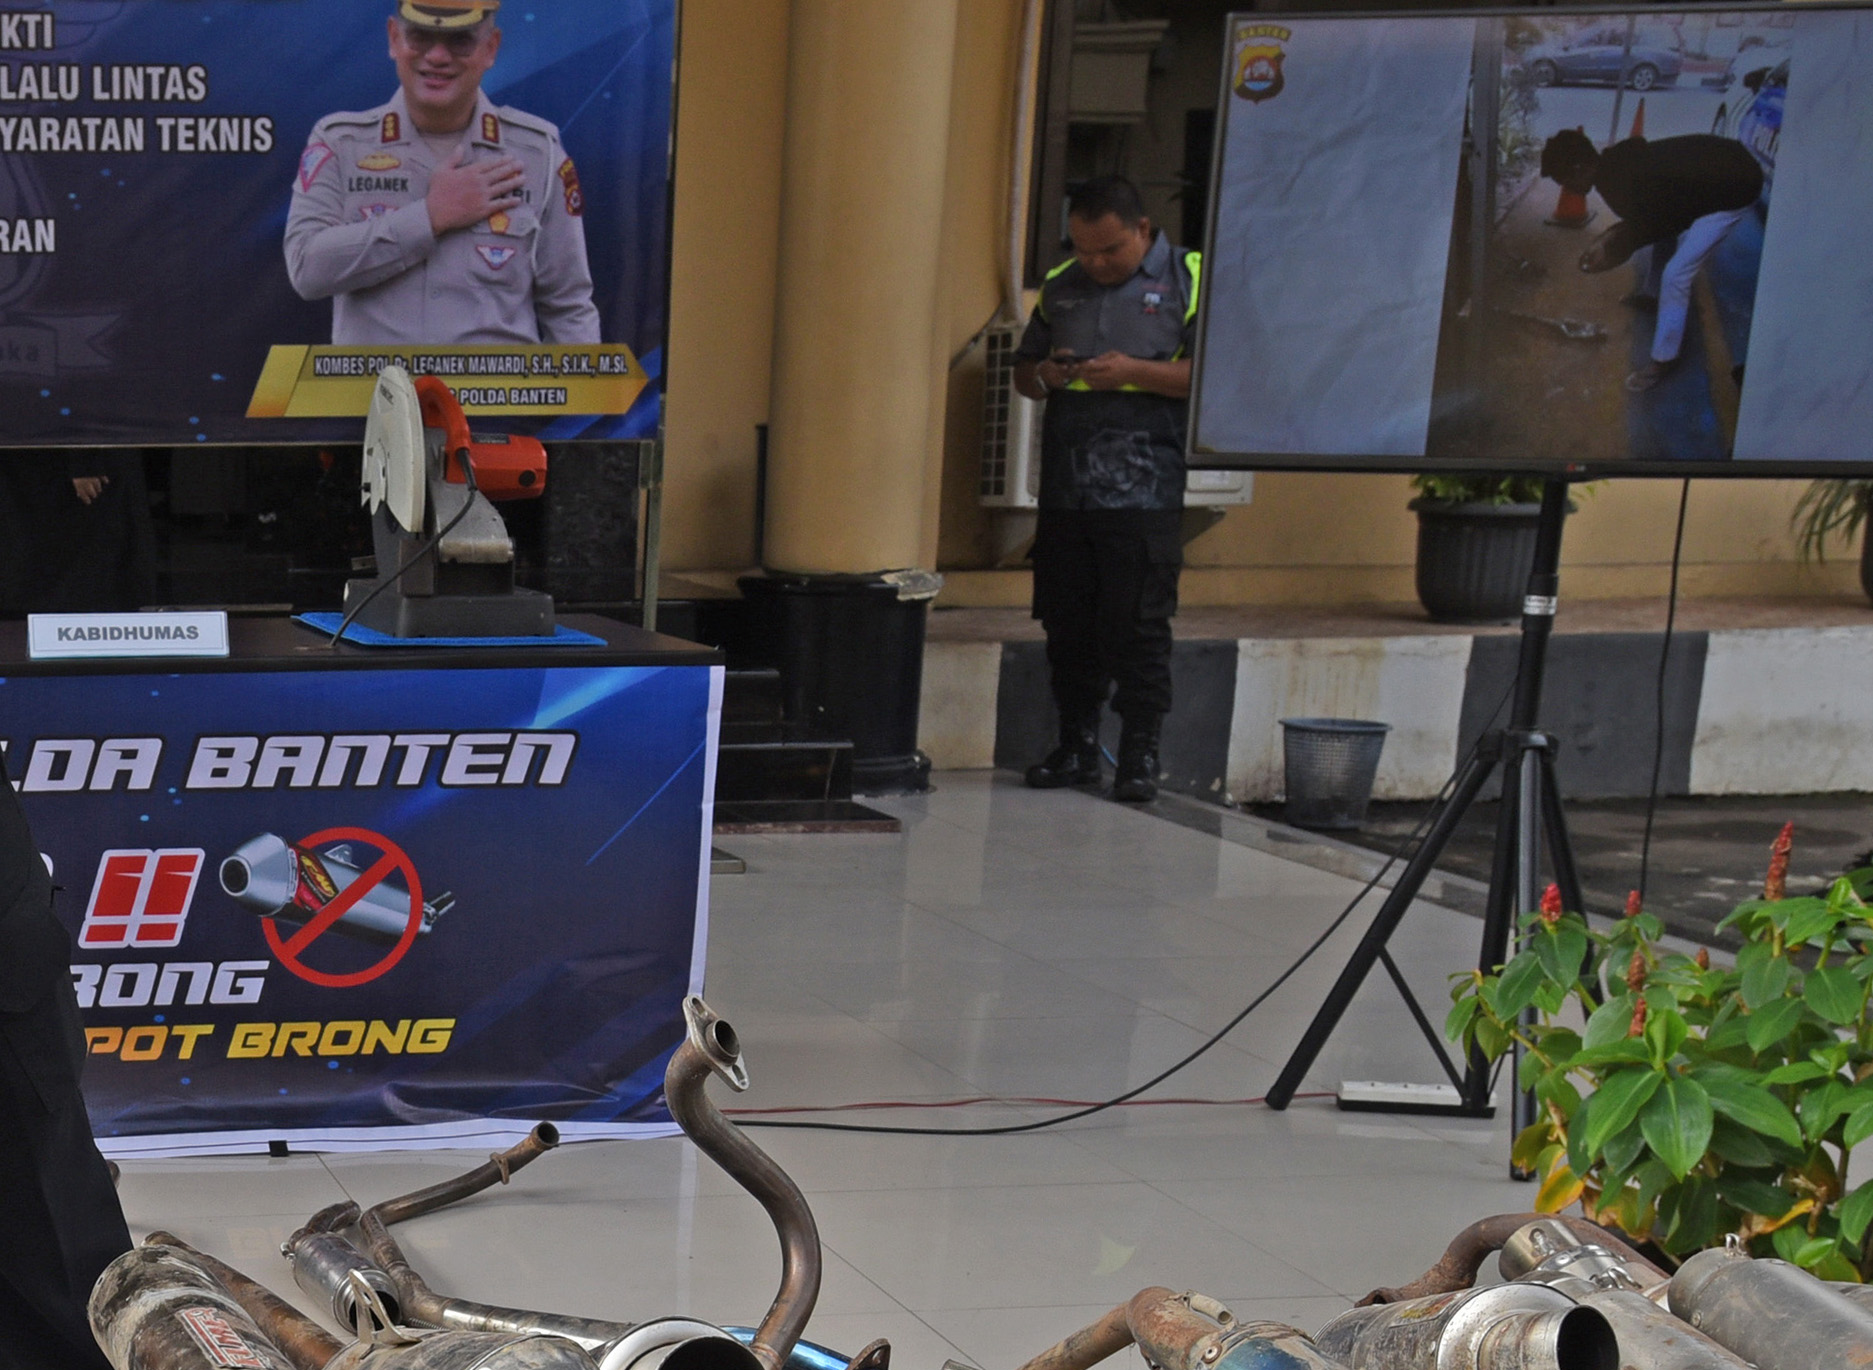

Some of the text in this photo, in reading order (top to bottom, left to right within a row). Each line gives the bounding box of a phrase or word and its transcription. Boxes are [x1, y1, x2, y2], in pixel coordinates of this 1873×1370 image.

[0, 65, 81, 101] LALU
[92, 66, 207, 102] LINTAS
[157, 117, 273, 153] TEKNIS
[348, 177, 409, 194] LEGANEK
[314, 356, 365, 375] KOMBES
[412, 356, 466, 375] LEGANEK
[469, 355, 528, 377] MAWARDI,
[532, 355, 559, 377] S.H.,
[562, 355, 595, 376] S.I.K.,
[460, 389, 506, 405] POLDA
[511, 388, 566, 405] BANTEN
[57, 624, 199, 643] KABIDHUMAS
[0, 732, 578, 791] DA BANTEN
[227, 1018, 456, 1060] BRONG
